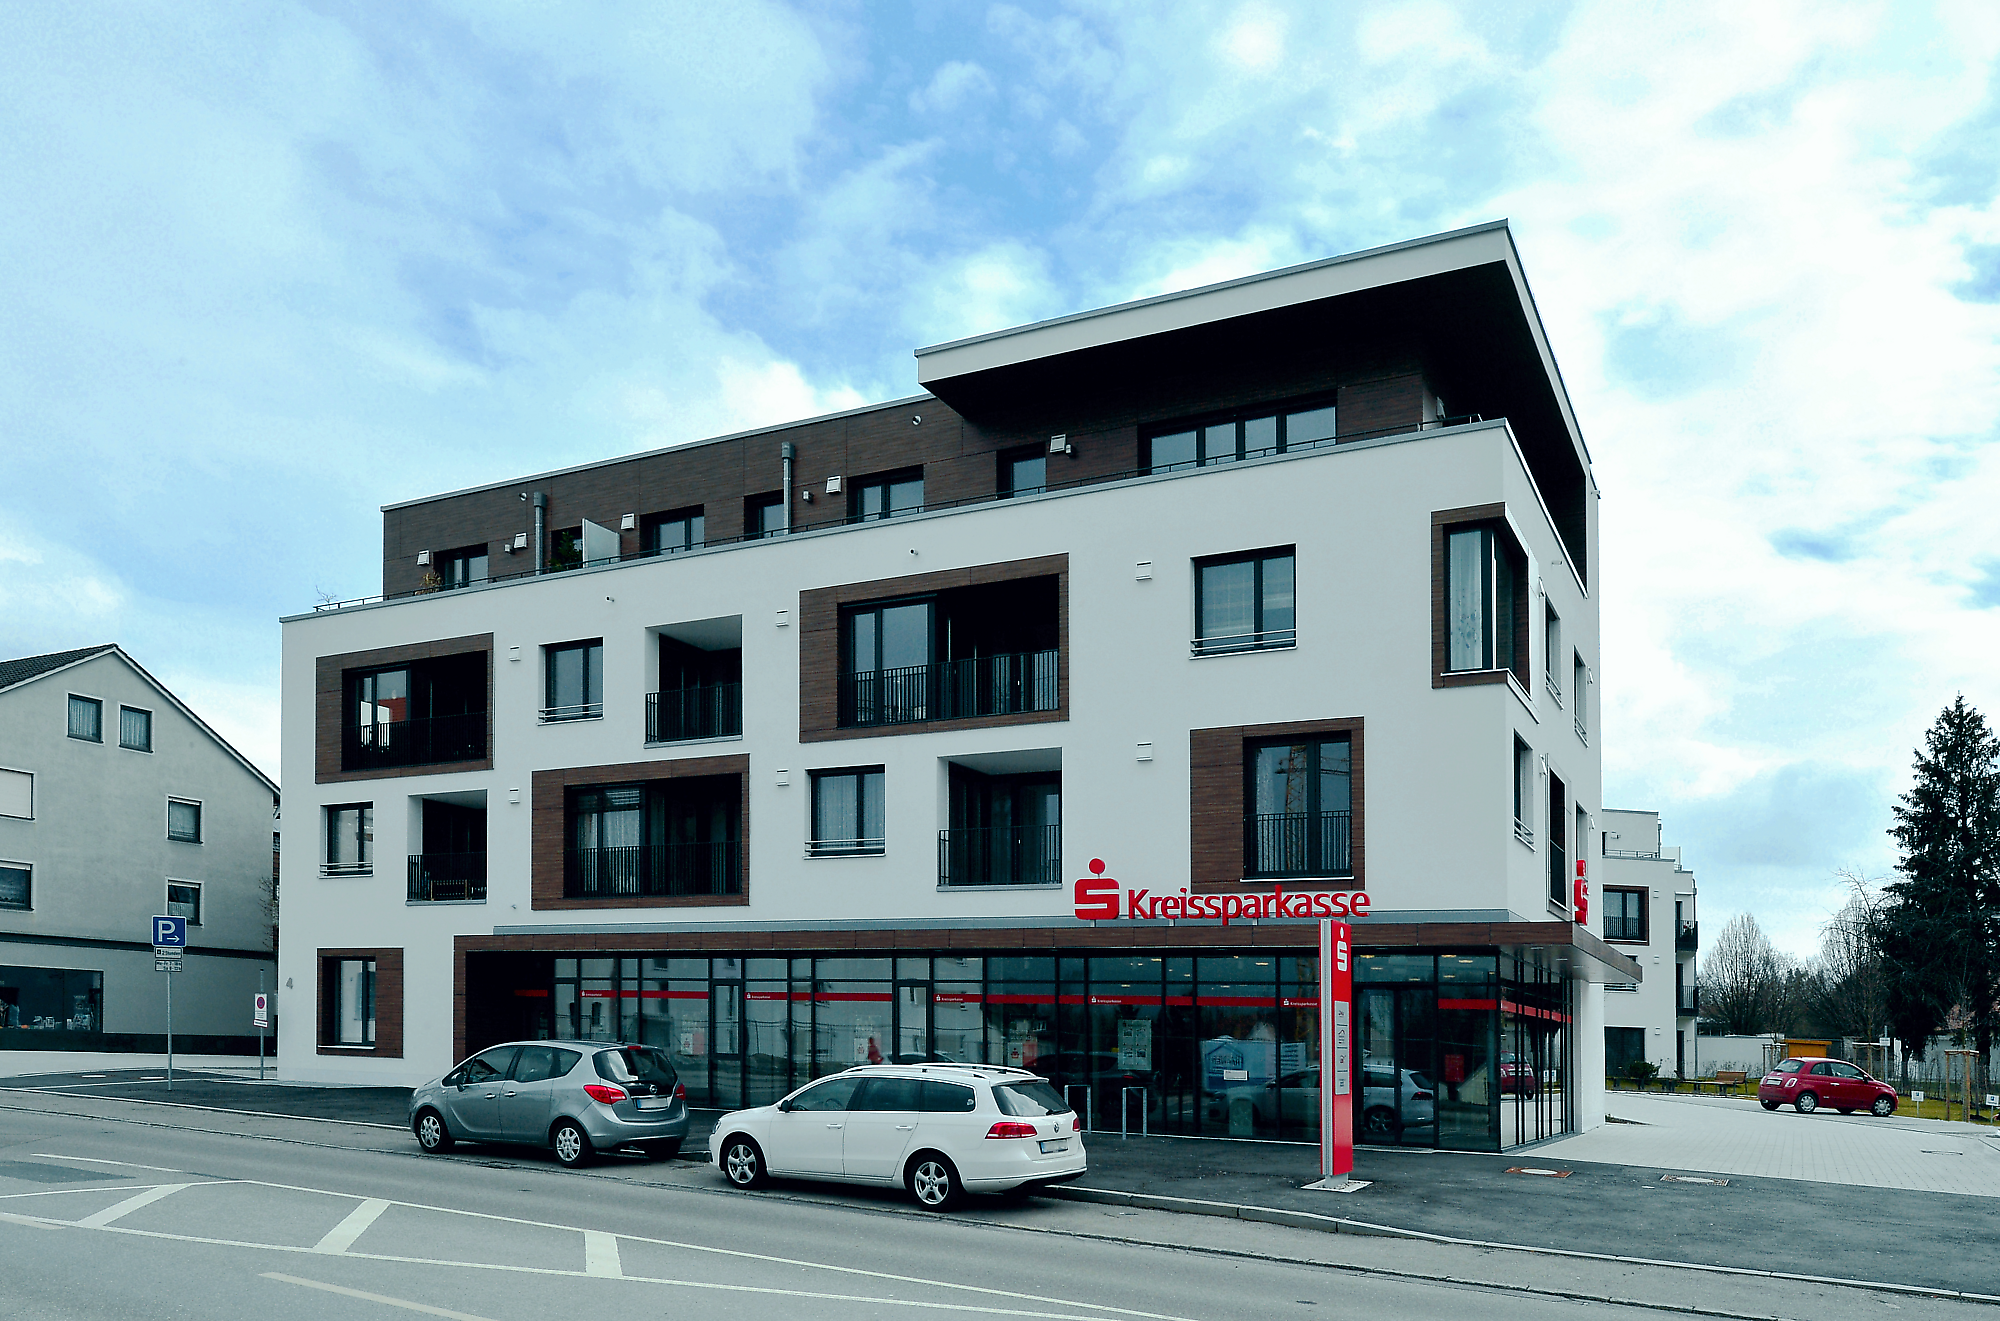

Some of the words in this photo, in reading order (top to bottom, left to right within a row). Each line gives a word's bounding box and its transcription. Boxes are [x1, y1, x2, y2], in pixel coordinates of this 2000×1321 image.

[1127, 884, 1371, 926] Kreissparkasse
[158, 920, 176, 942] P
[286, 977, 293, 989] 4
